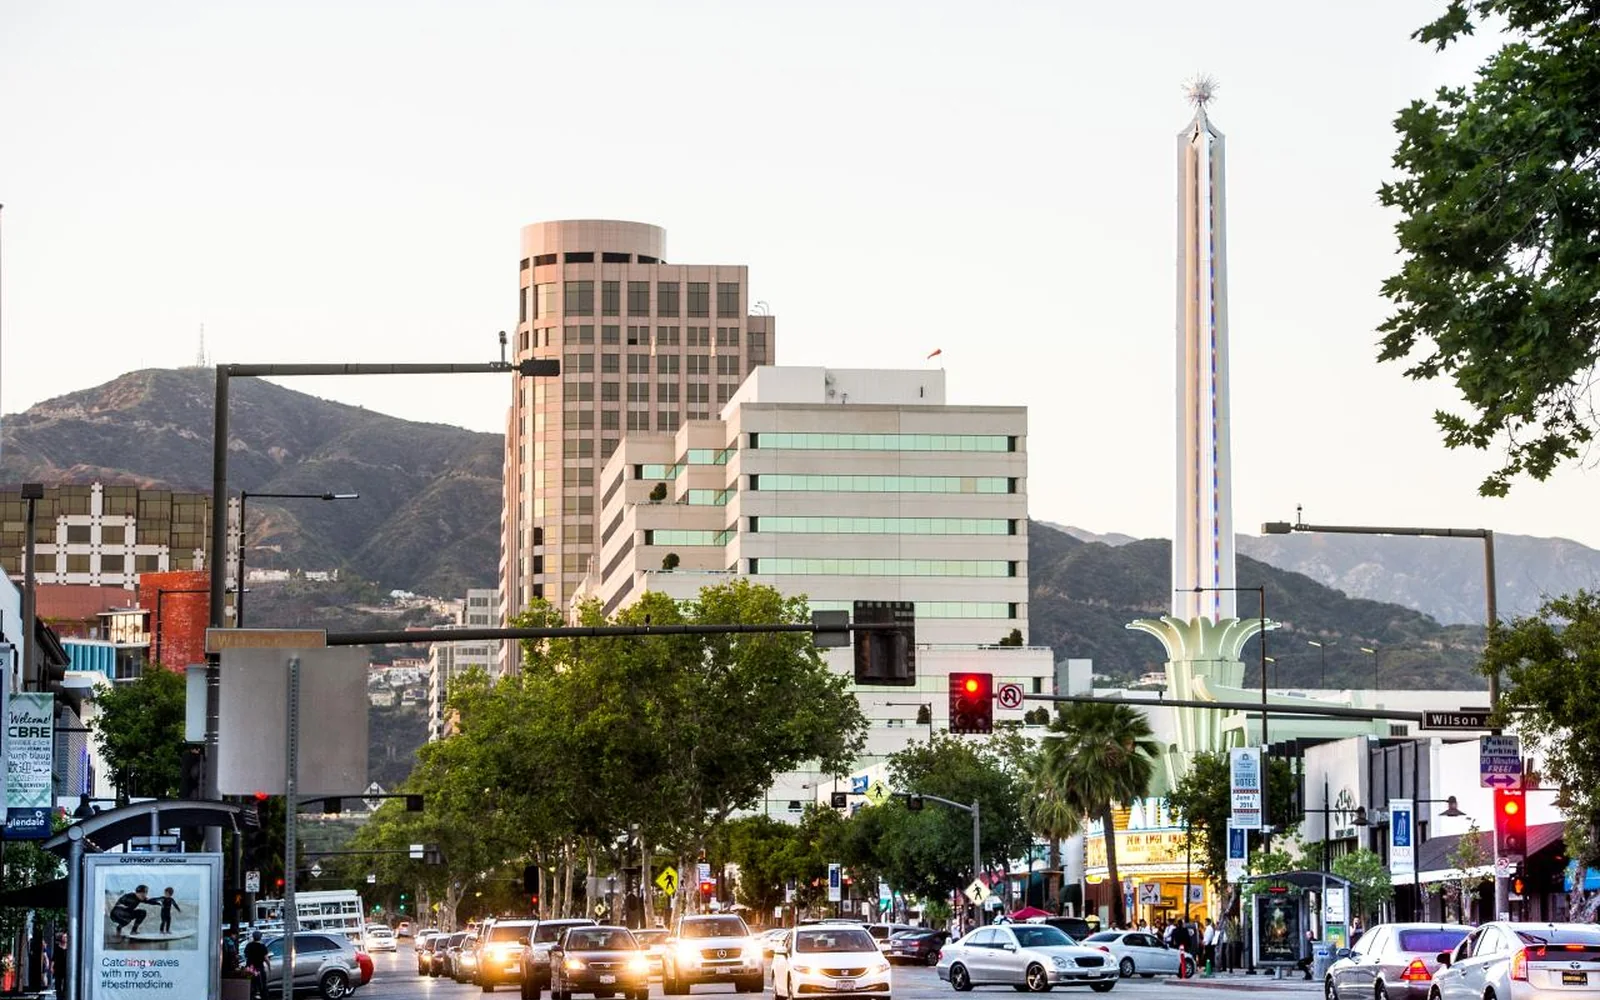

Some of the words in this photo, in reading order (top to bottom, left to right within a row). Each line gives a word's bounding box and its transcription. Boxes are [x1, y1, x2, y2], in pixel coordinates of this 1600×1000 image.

[10, 711, 52, 724] Welcome!
[1432, 714, 1478, 725] Wilson
[8, 726, 51, 738] CBRE
[1486, 736, 1513, 746] Public
[1482, 745, 1517, 755] Parking
[1493, 757, 1520, 765] Minutes
[101, 957, 146, 969] Catching
[148, 959, 180, 967] waves
[101, 968, 122, 978] with
[124, 970, 139, 979] my
[142, 970, 162, 978] son.
[101, 979, 173, 989] #bestmedicine
